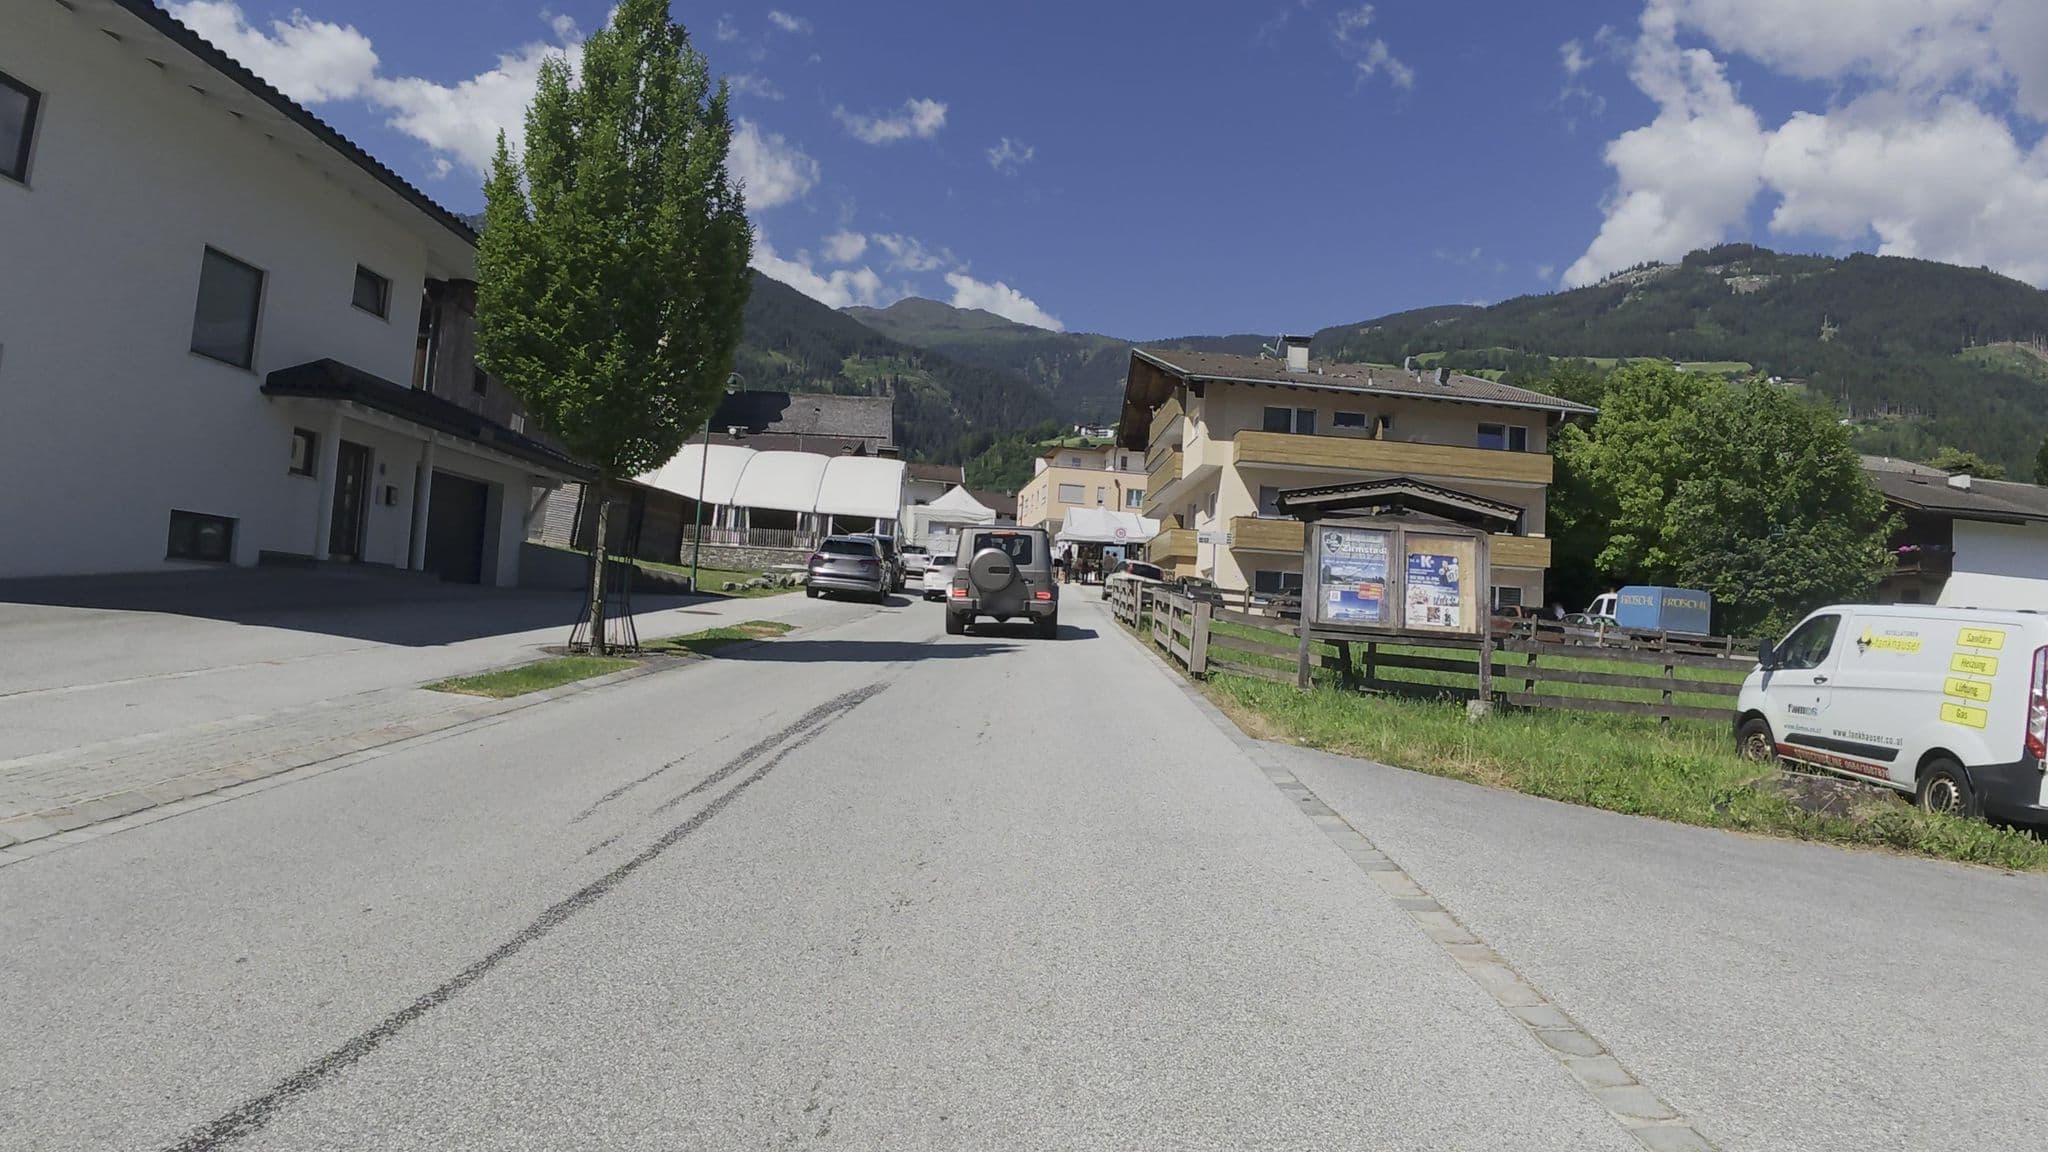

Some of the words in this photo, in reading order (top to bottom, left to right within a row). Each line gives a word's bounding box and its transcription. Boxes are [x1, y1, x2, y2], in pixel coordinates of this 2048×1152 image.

[1961, 657, 1987, 672] Heizung
[1955, 682, 1979, 697] Lüftung
[1956, 708, 1968, 720] Gas
